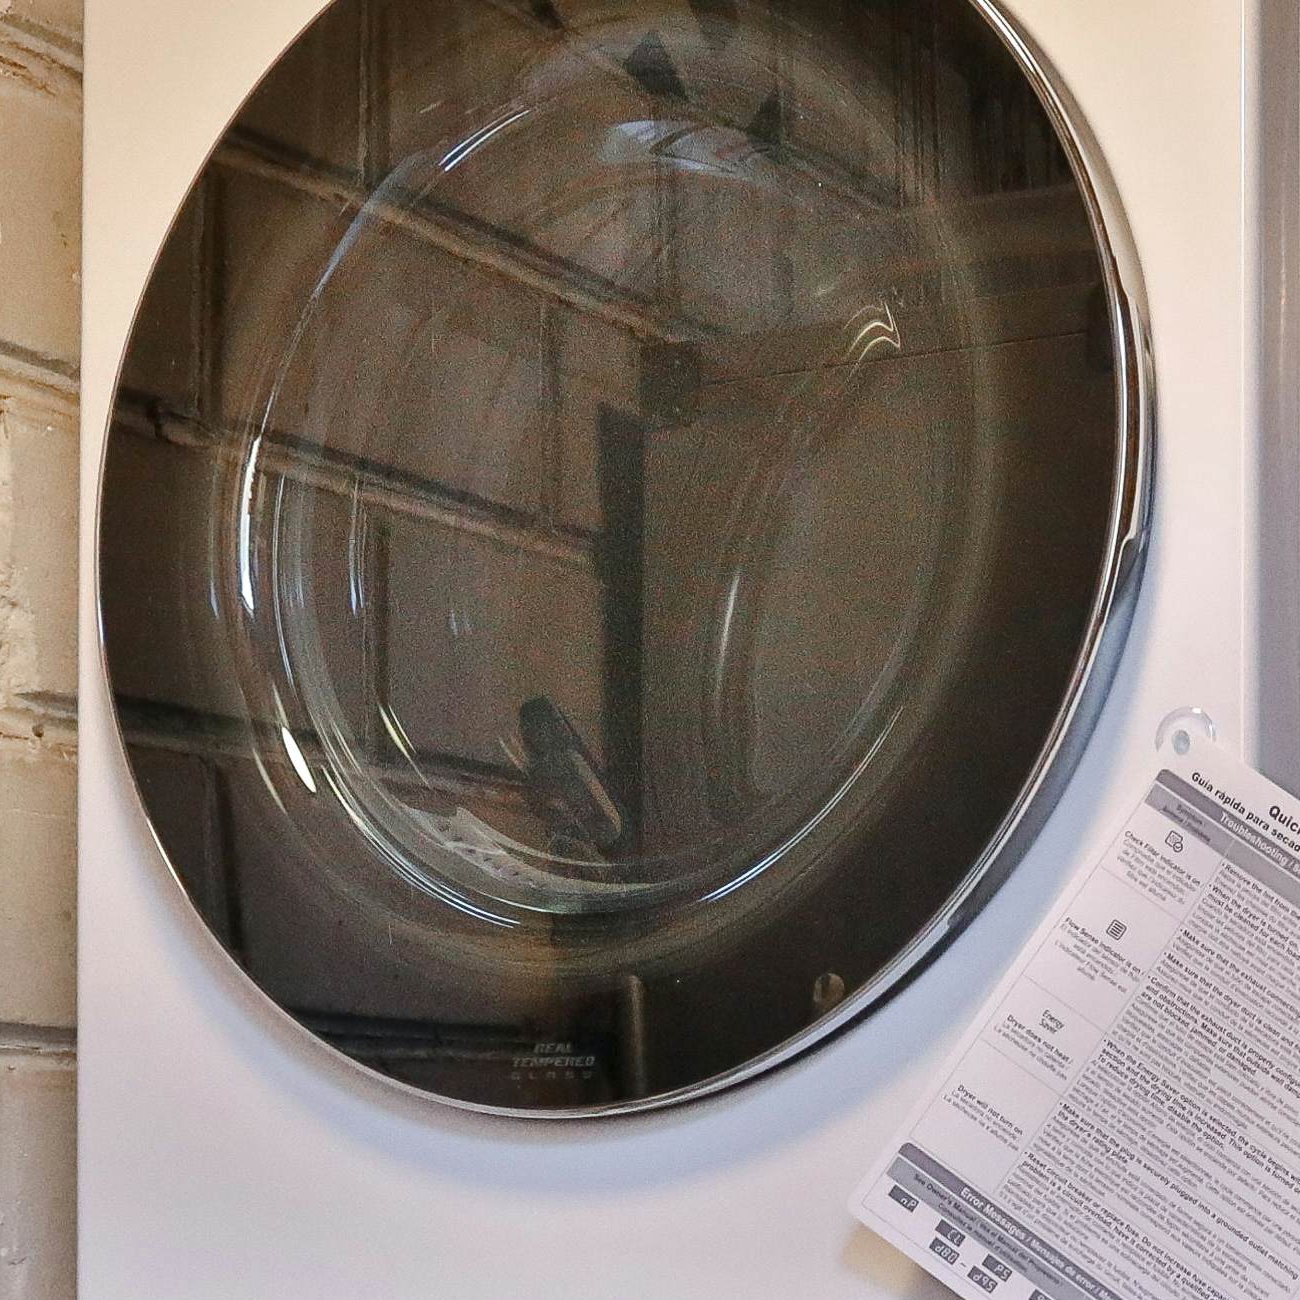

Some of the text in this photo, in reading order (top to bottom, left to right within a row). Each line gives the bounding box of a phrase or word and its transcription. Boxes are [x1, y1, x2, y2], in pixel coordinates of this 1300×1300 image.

[1245, 811, 1269, 831] para
[1220, 812, 1288, 866] Troubleshooting
[1039, 1018, 1058, 1034] Saver
[1042, 1009, 1064, 1029] Energy
[1006, 1014, 1069, 1062] Dryer does not heat
[957, 1084, 976, 1101] Dryer
[976, 1099, 988, 1109] will
[987, 1107, 1000, 1119] not
[999, 1115, 1013, 1129] turn
